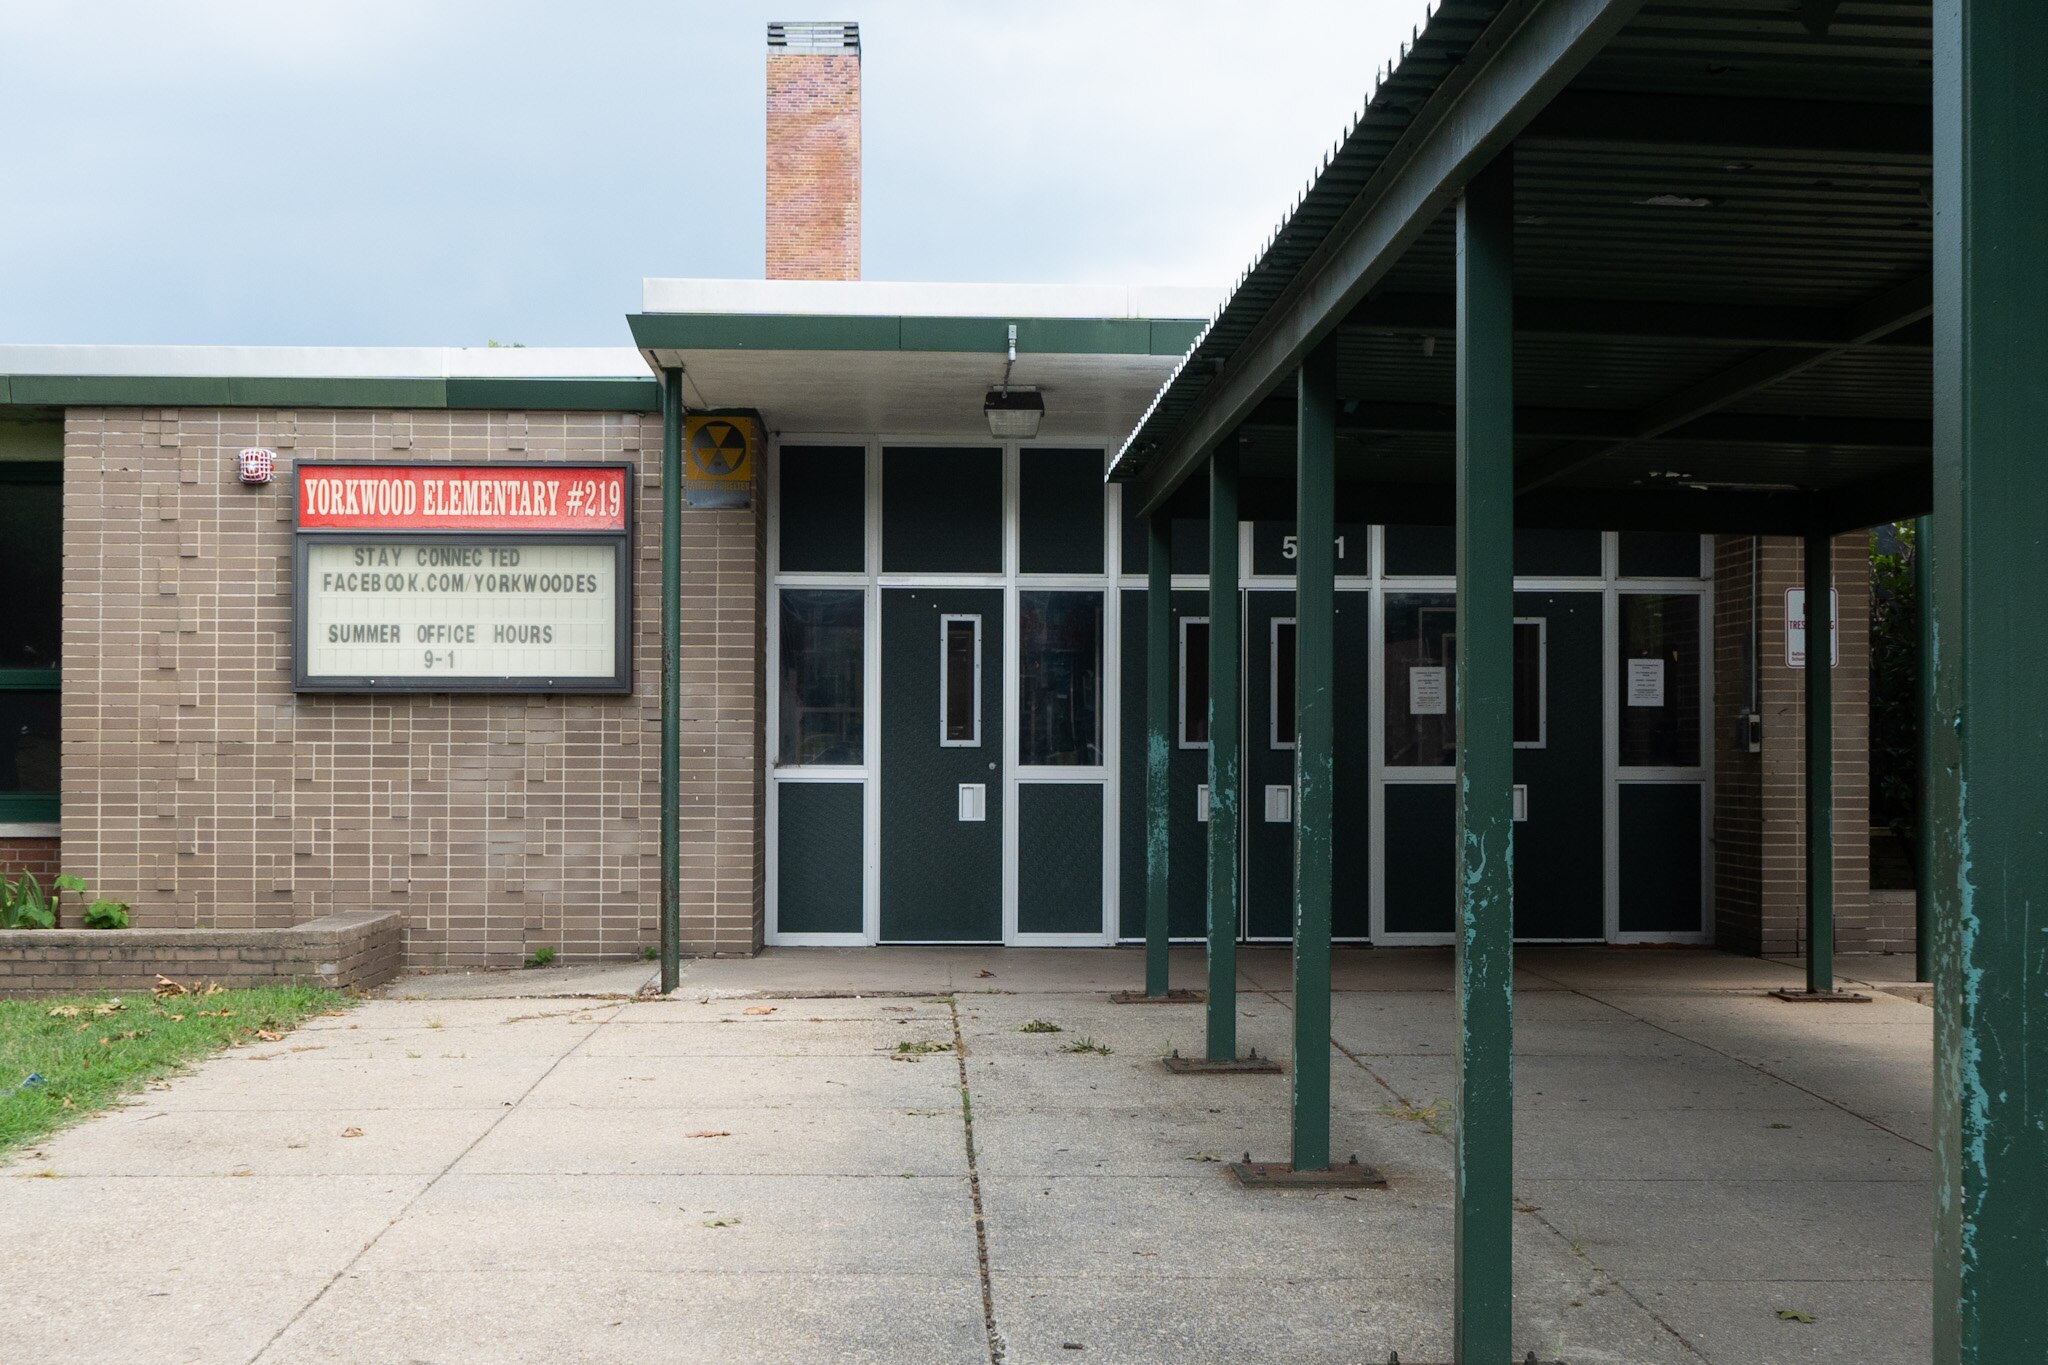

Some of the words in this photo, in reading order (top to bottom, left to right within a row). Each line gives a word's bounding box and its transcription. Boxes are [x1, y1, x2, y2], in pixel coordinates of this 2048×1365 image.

[305, 479, 416, 516] YORKWOOD
[423, 480, 559, 516] ELEMENTARY
[566, 480, 620, 517] #219
[355, 548, 401, 567] STAY
[323, 573, 597, 593] FACEBOOK.COM/YORKWOODES
[328, 624, 401, 643] SUMMER
[417, 625, 475, 643] OFFICE
[494, 625, 553, 643] HOURS
[424, 650, 455, 669] 9-1
